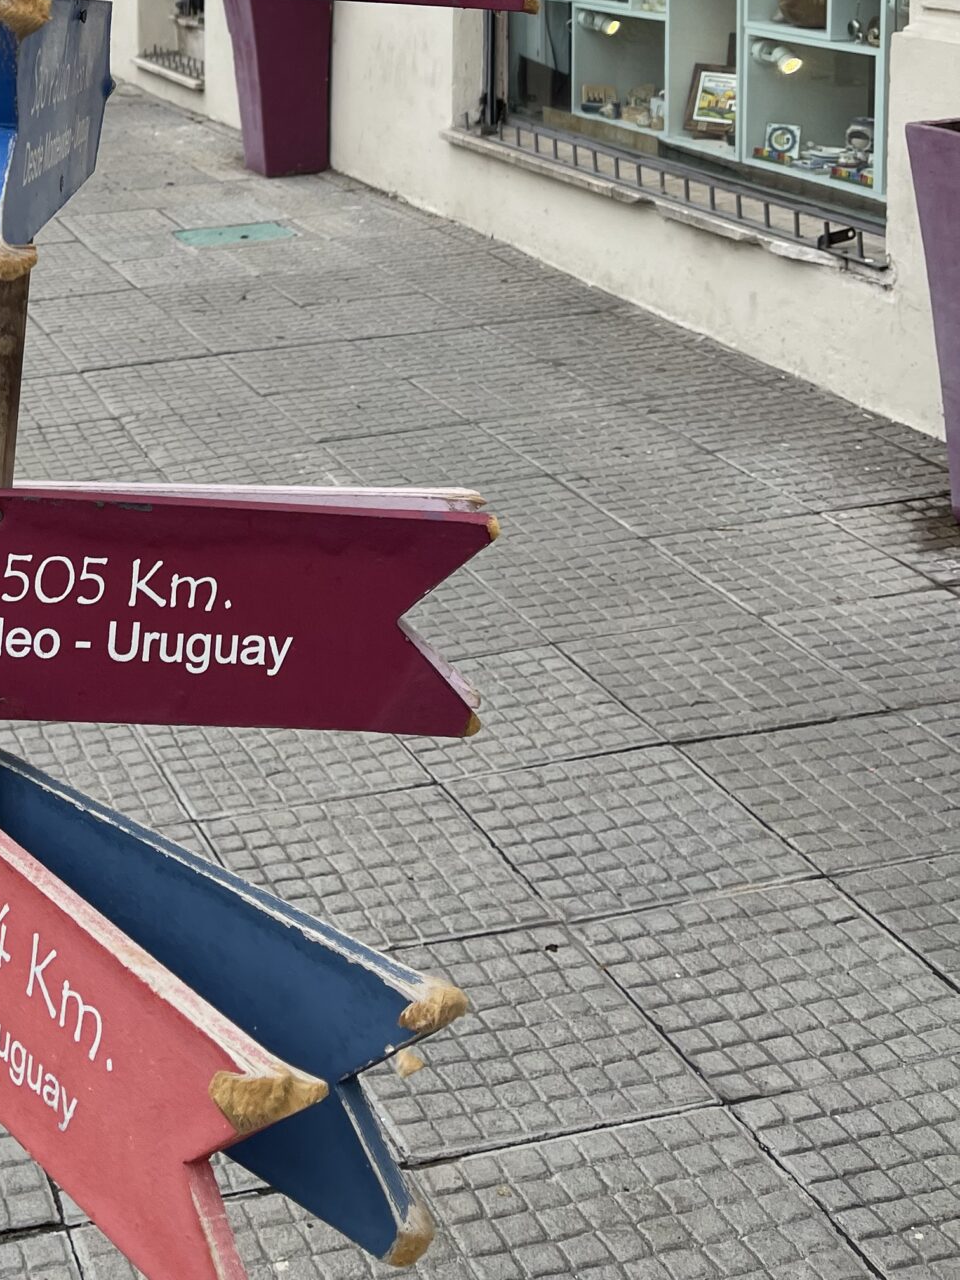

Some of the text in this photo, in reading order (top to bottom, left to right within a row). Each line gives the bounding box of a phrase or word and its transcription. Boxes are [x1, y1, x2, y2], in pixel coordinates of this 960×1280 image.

[128, 558, 233, 612] Km.
[107, 620, 294, 676] Uruguay
[25, 932, 114, 1072] Km.
